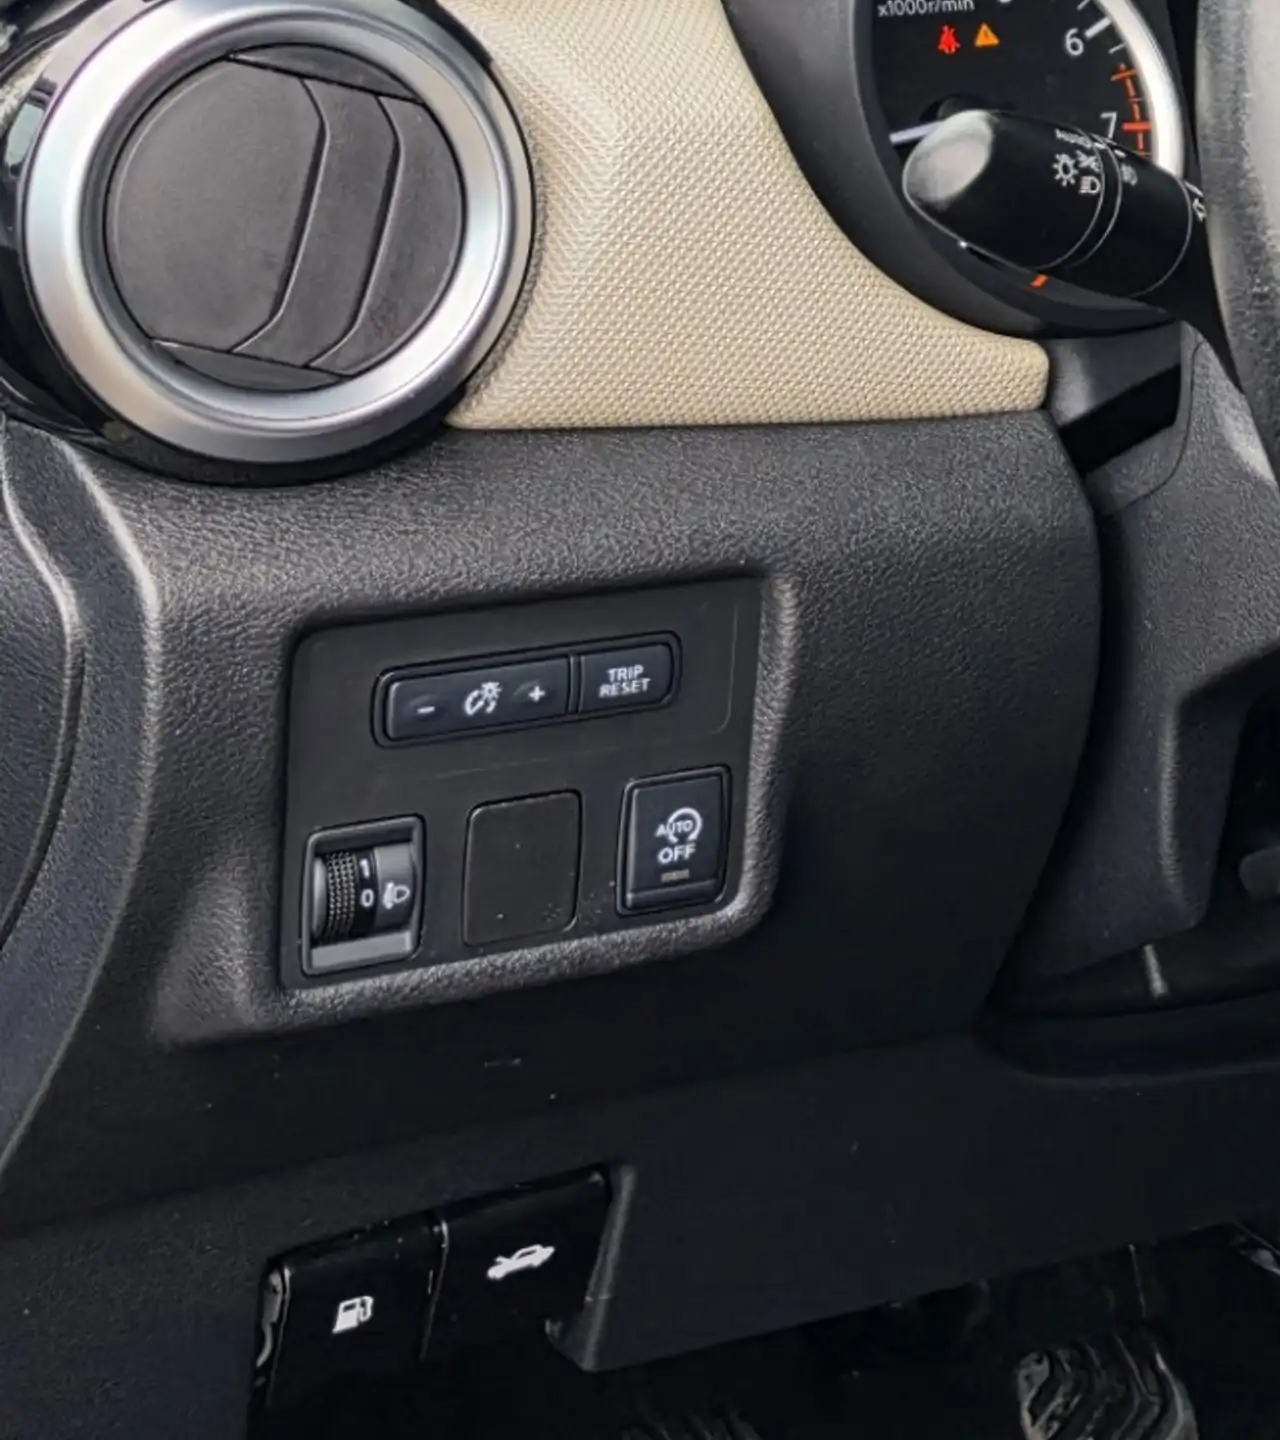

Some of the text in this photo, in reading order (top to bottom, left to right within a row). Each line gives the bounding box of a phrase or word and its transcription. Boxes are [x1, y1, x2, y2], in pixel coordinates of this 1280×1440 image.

[1063, 30, 1084, 57] 6
[1100, 111, 1118, 140] 7
[608, 664, 645, 681] TRIP
[600, 678, 650, 697] RESET
[656, 817, 694, 838] AUTO
[658, 843, 697, 864] OFF
[361, 888, 375, 908] 0
